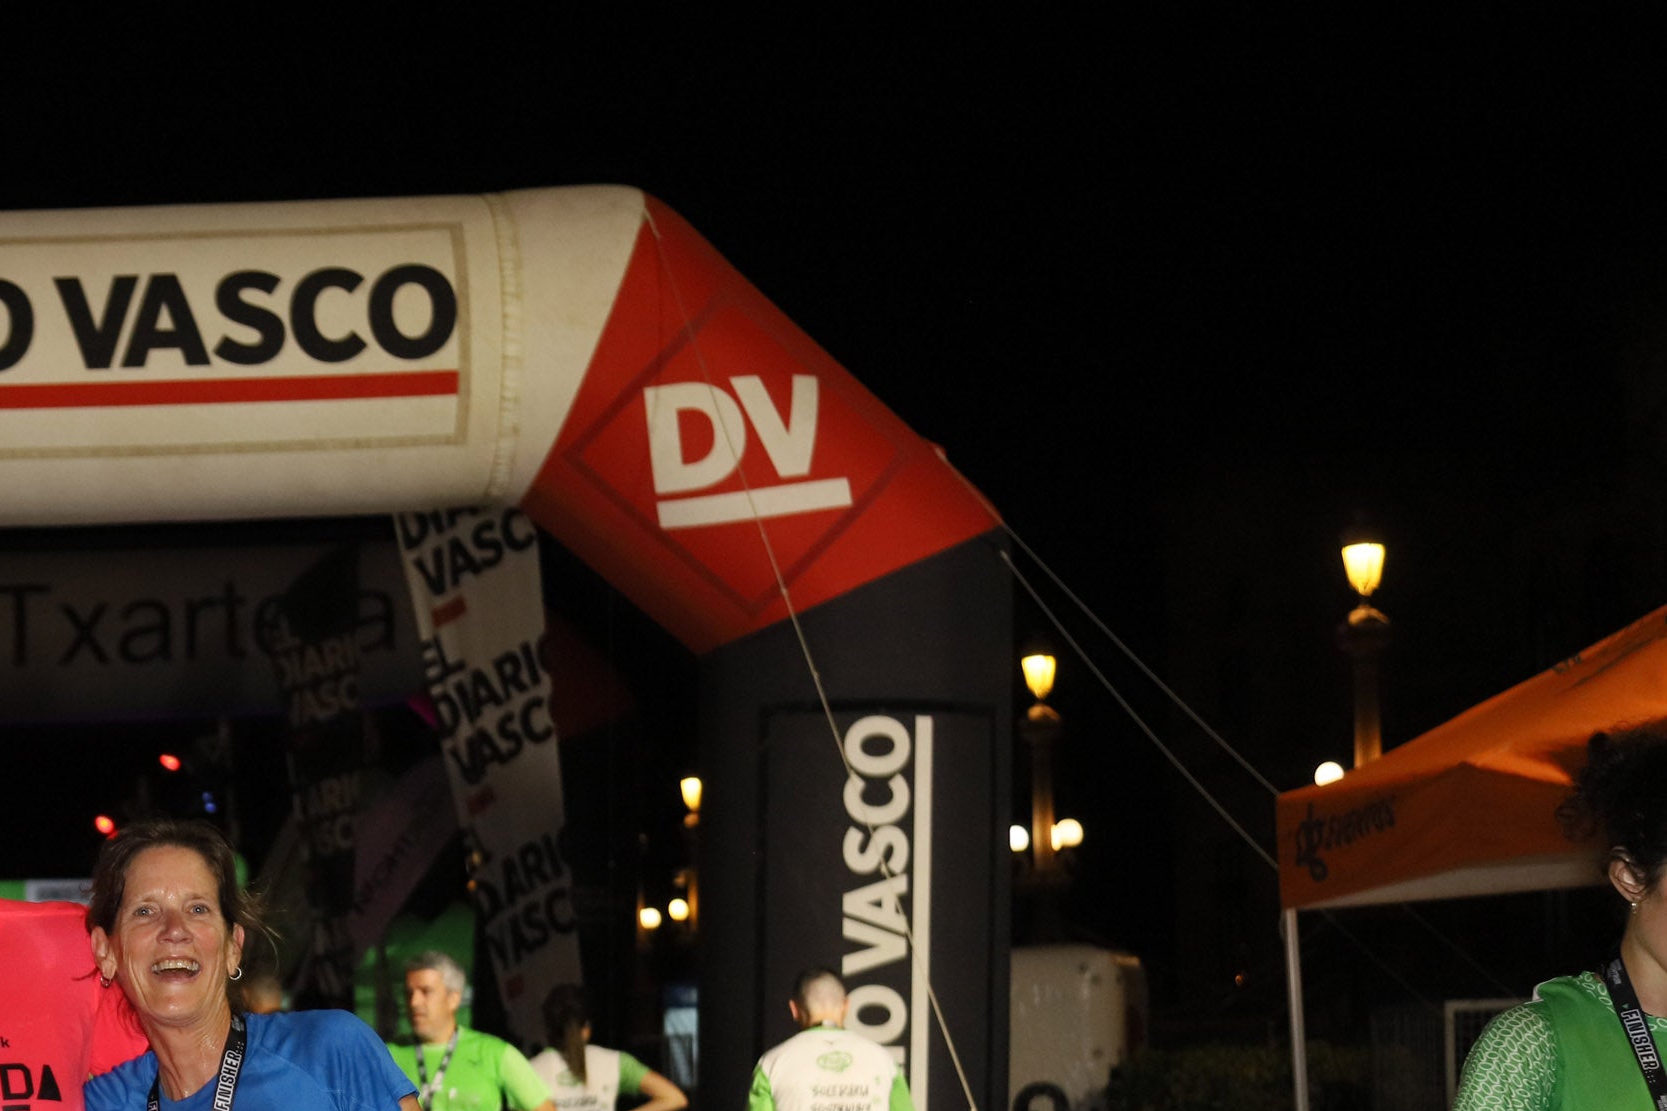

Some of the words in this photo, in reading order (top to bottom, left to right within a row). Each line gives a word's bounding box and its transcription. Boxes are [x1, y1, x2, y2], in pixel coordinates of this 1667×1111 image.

[54, 263, 458, 370] VASCO
[644, 373, 819, 496] DV
[414, 508, 535, 595] VASC
[433, 641, 542, 738] DIARI
[449, 697, 553, 785] VASC
[841, 713, 912, 977] VASCO
[1621, 1008, 1660, 1074] FINISHER
